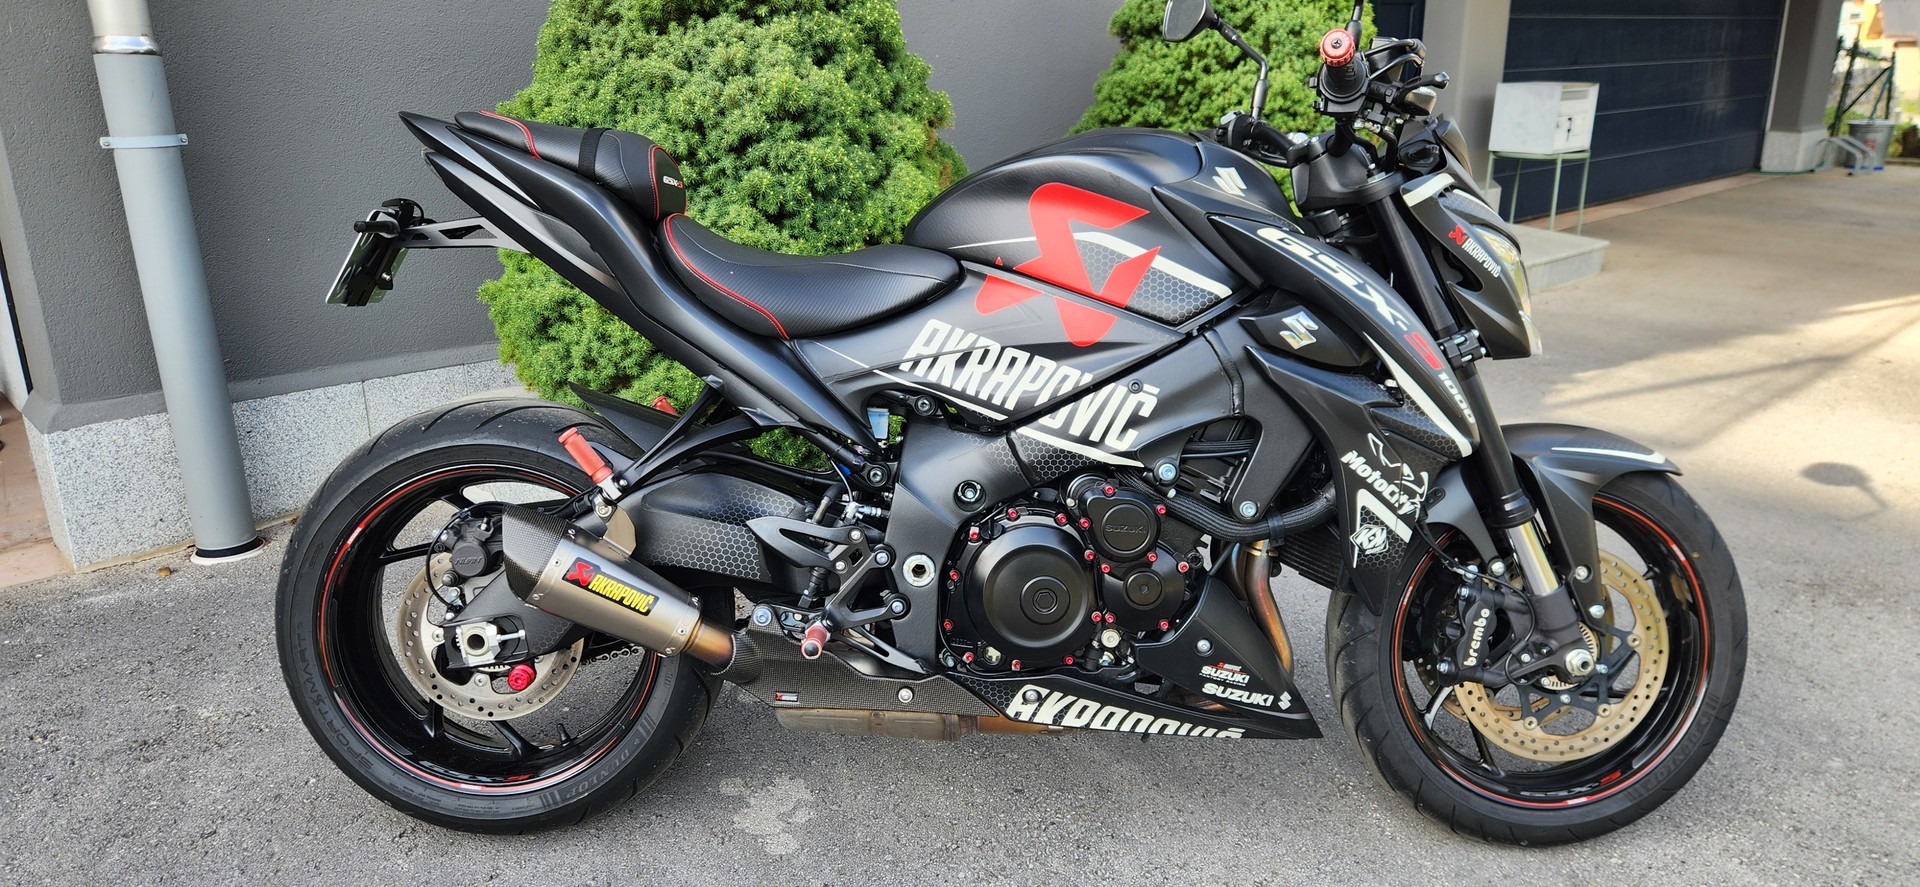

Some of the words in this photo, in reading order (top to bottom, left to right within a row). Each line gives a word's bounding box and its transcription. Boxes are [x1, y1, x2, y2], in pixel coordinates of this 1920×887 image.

[1256, 227, 1444, 370] GSX-S
[1438, 371, 1476, 424] 1000
[1105, 524, 1147, 534] SUZUKI
[1463, 608, 1490, 667] brembo
[1201, 665, 1250, 684] SUZUKI
[1202, 682, 1274, 707] SUZUKI
[566, 749, 630, 799] DUNLOP
